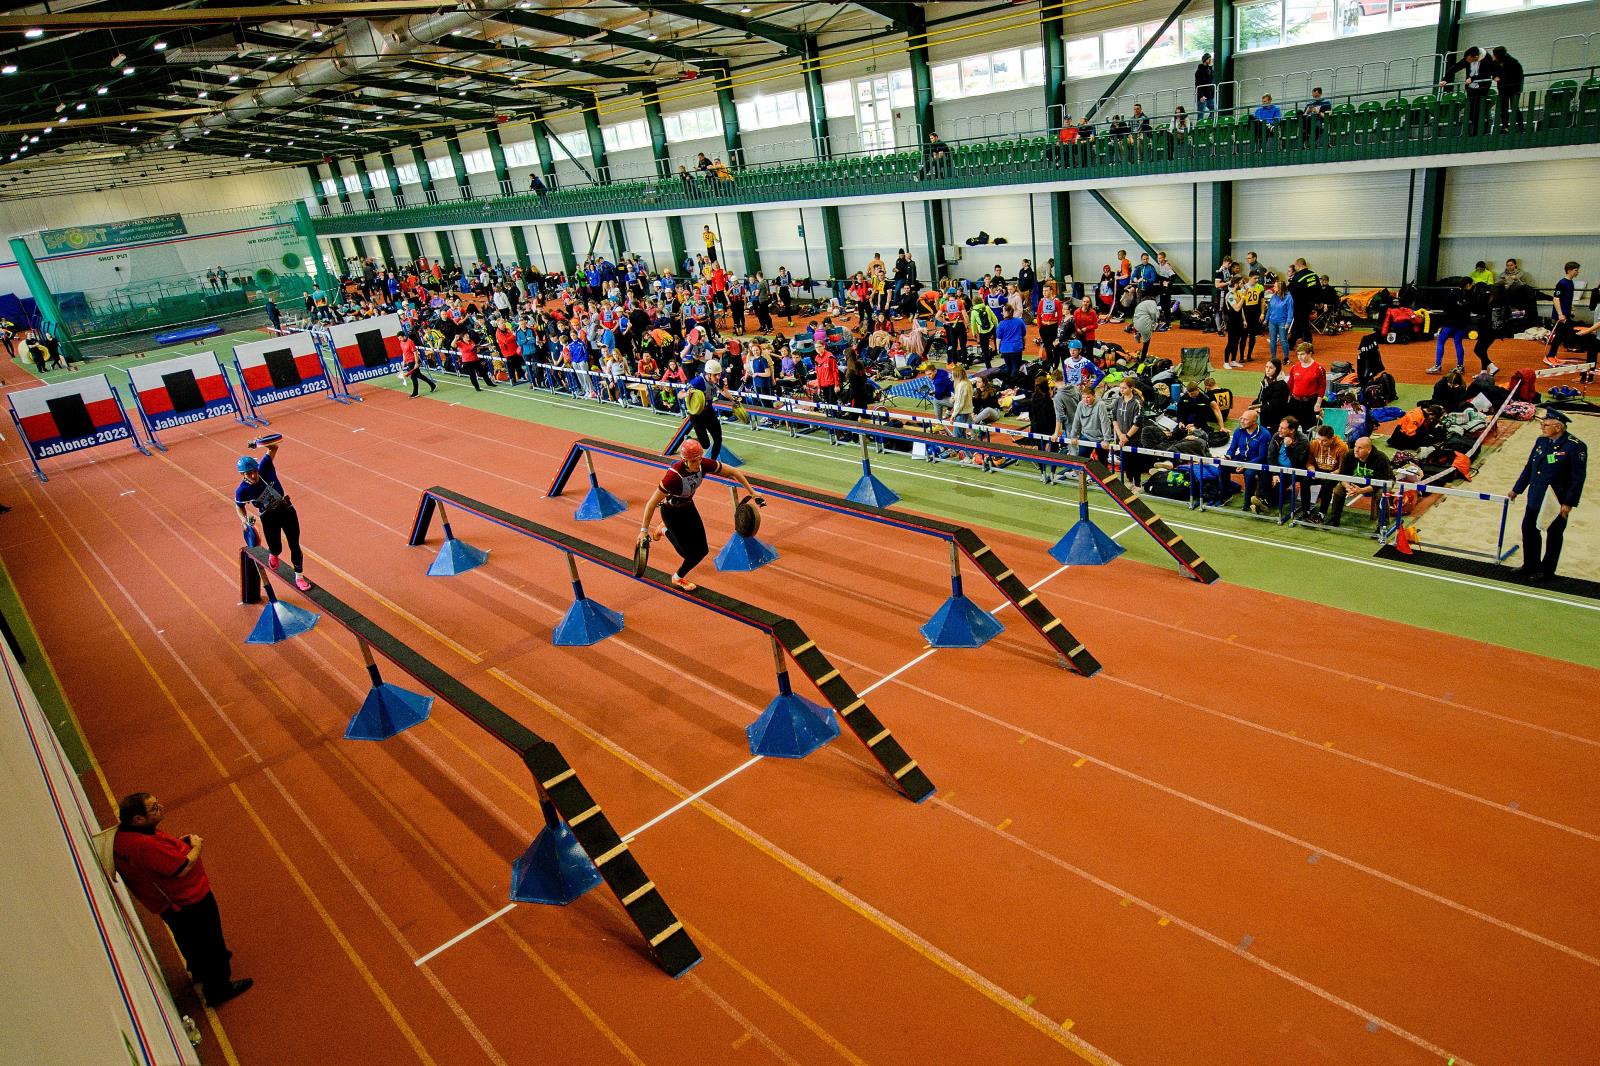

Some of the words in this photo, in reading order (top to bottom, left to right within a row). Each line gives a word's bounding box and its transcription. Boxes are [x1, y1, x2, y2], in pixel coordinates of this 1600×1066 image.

[1247, 290, 1258, 302] 26
[348, 365, 389, 383] Jablonec
[256, 387, 302, 406] Jablonec
[302, 379, 328, 394] 2023
[154, 411, 206, 431] Jablonec
[206, 403, 234, 418] 2023
[39, 436, 96, 457] Jablonec
[96, 427, 128, 443] 2023
